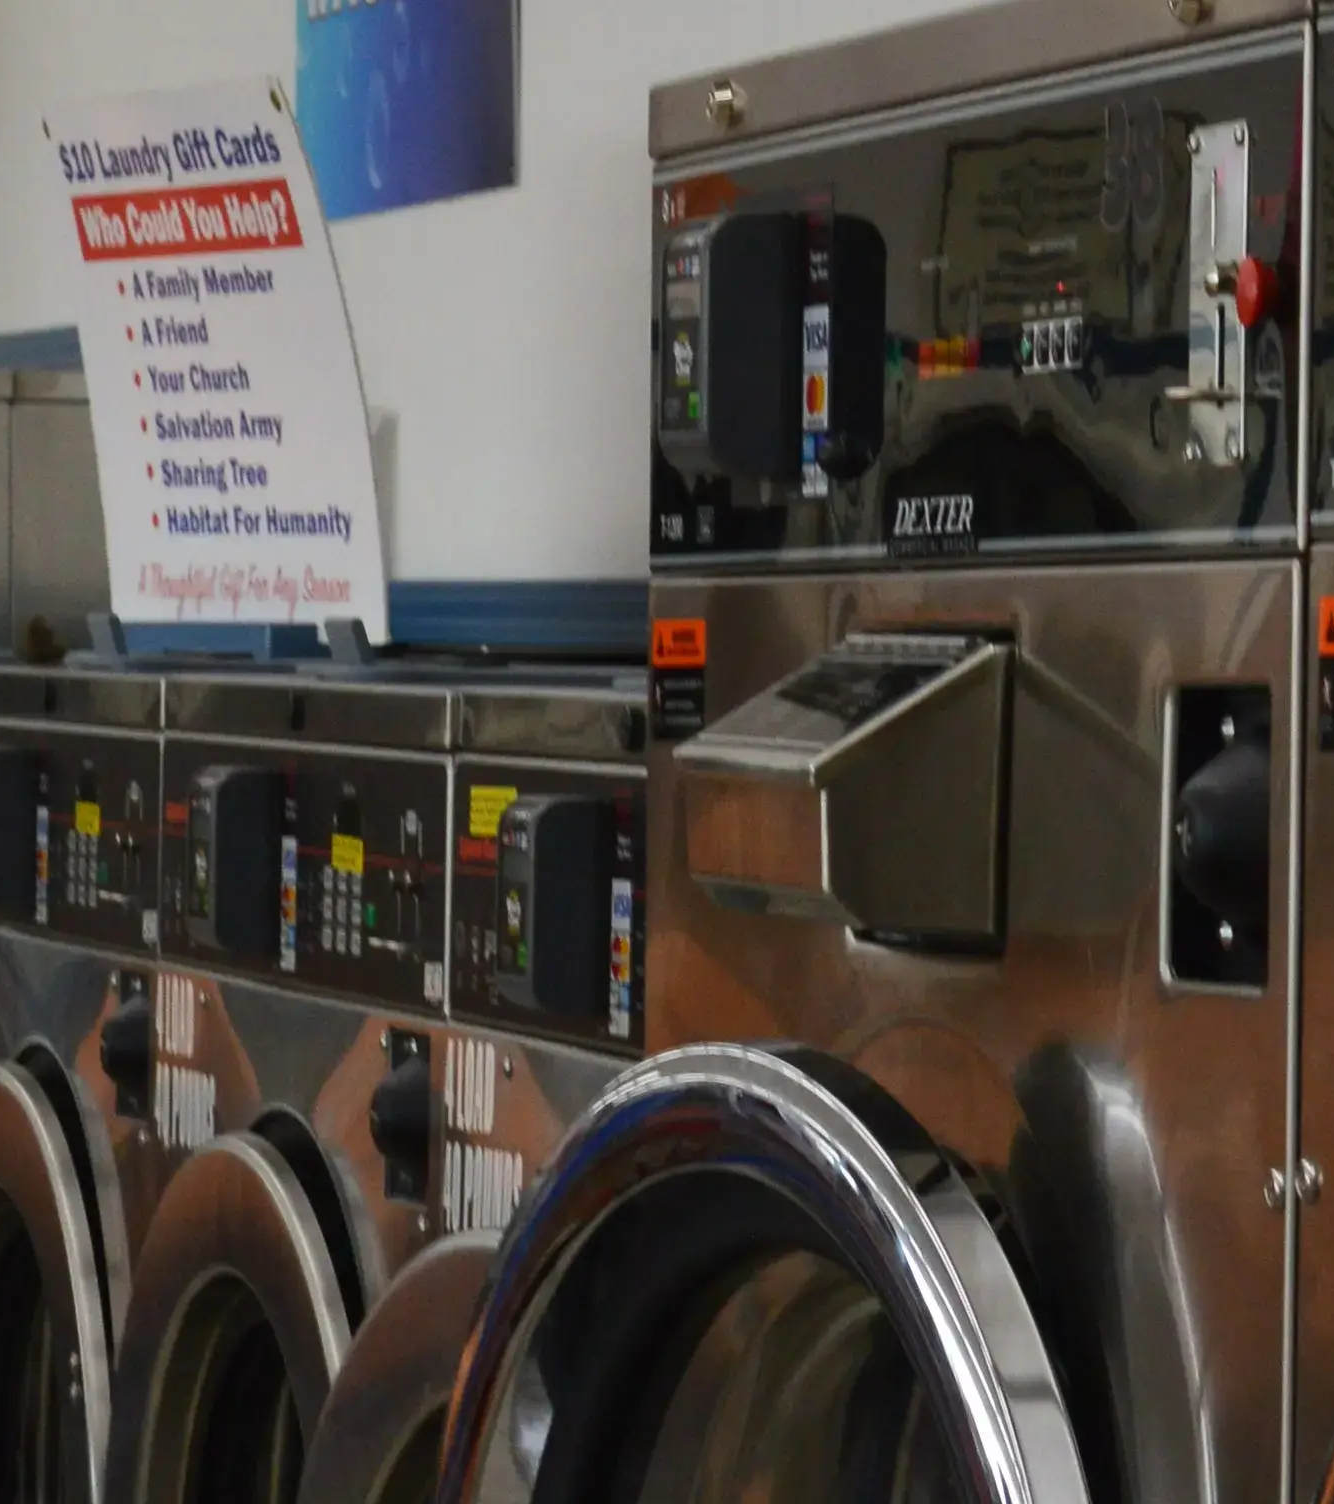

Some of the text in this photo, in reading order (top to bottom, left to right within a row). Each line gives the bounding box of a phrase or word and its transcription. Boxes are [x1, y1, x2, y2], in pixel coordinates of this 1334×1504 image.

[59, 121, 282, 184] $10 Laundry Gift Cards
[78, 186, 289, 250] Who Could You Help?
[133, 265, 275, 303] A Family Member
[141, 313, 209, 347] A Friend
[804, 319, 829, 354] VISA
[147, 361, 251, 393] Your Church
[155, 409, 284, 446] Salvation Army
[161, 457, 269, 493] Sharing Tree
[166, 504, 353, 543] Habitat For Humanity
[893, 493, 974, 537] DEXTER
